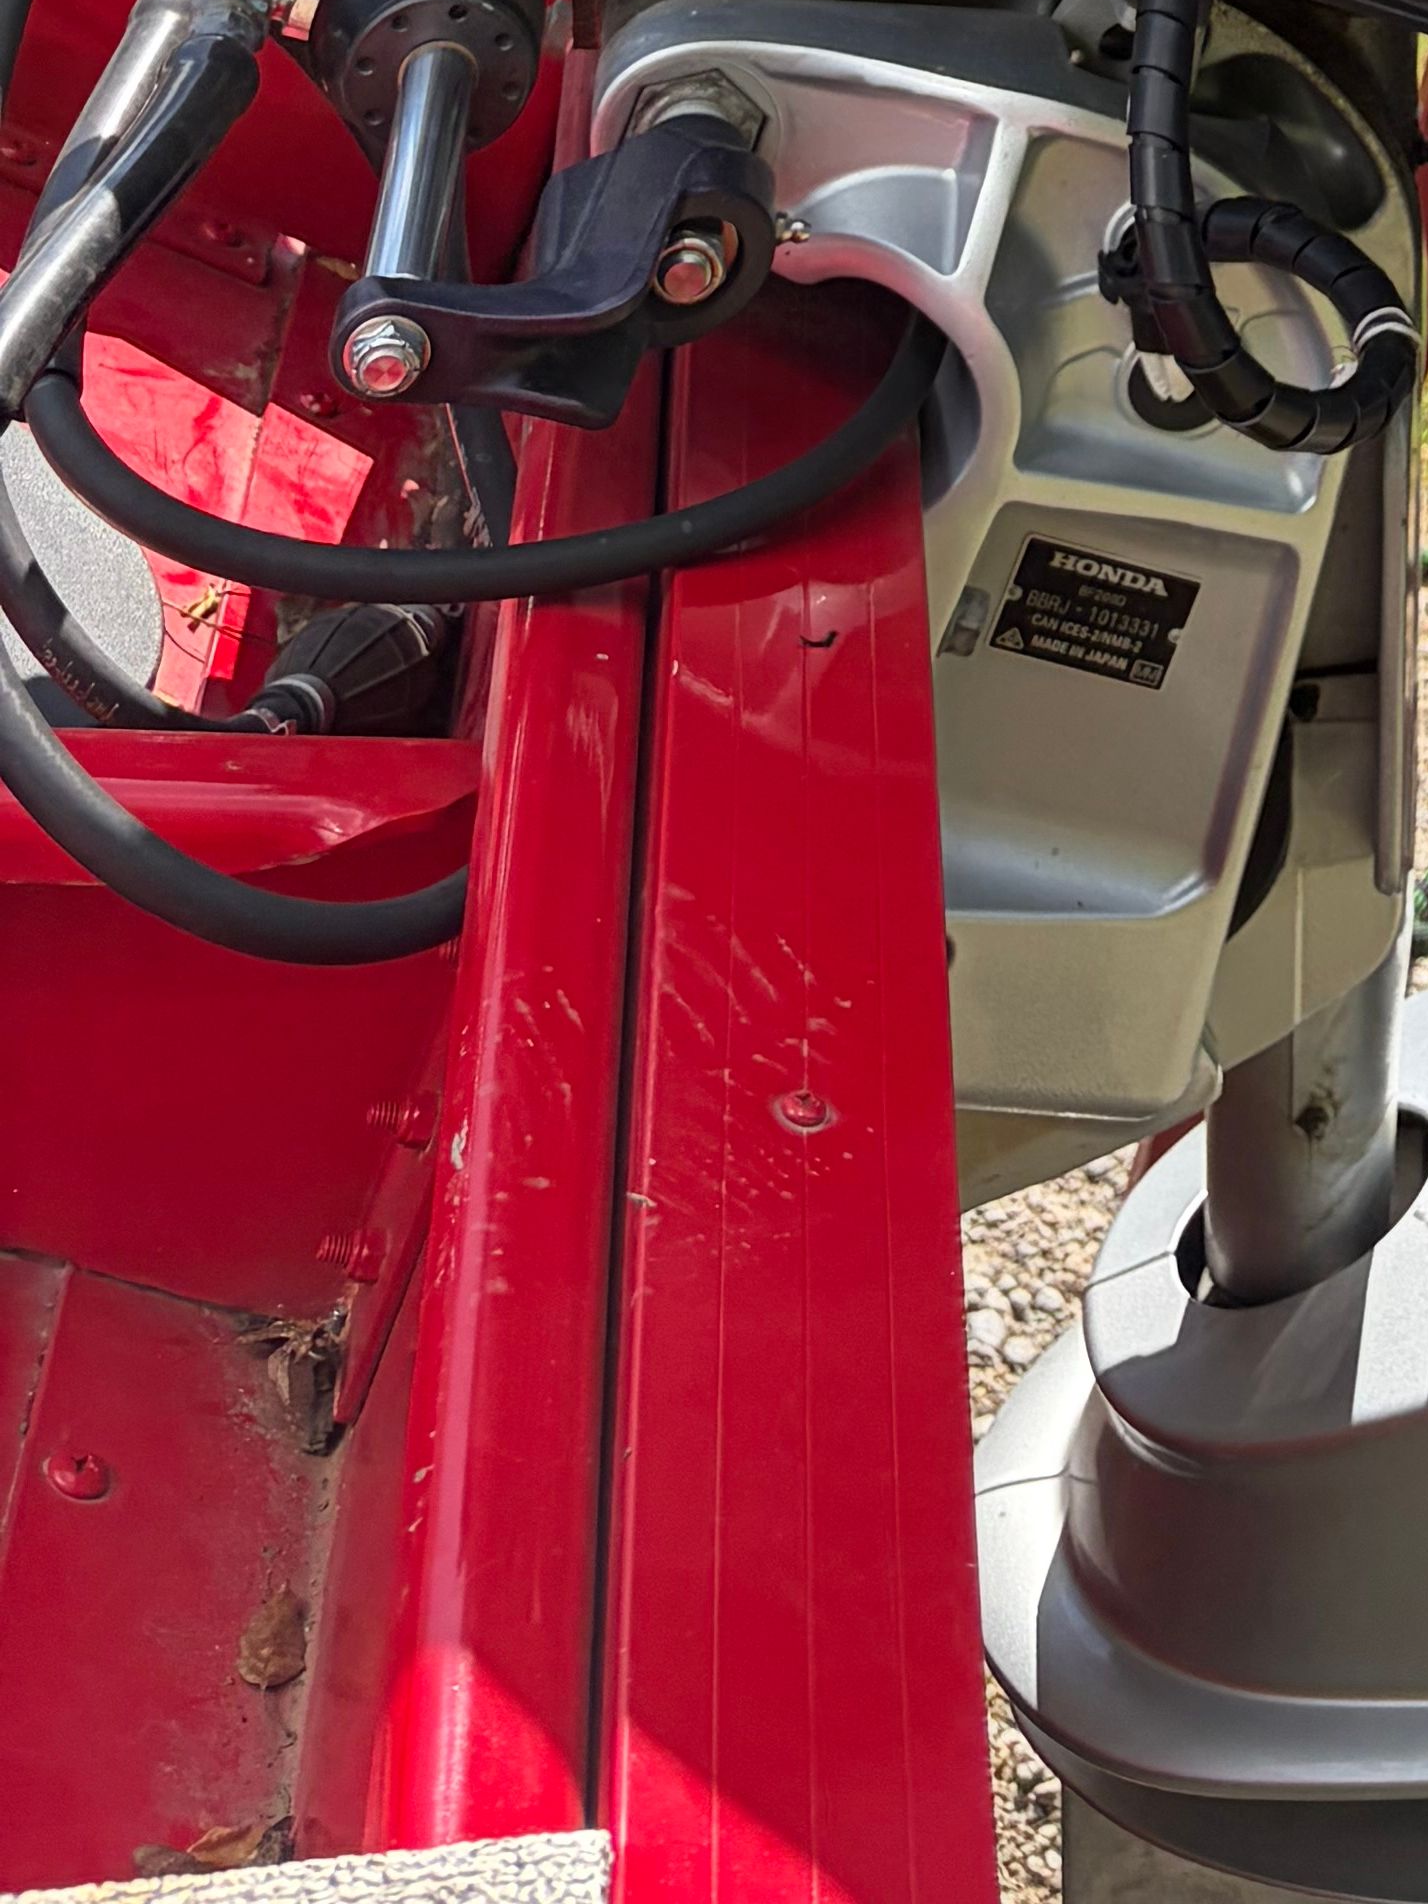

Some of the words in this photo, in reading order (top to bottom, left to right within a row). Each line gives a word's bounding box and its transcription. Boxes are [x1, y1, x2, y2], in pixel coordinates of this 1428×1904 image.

[1049, 551, 1169, 598] HONDA
[1030, 634, 1068, 655] MADE
[1069, 642, 1086, 659] IN
[1085, 646, 1129, 672] JAPAN
